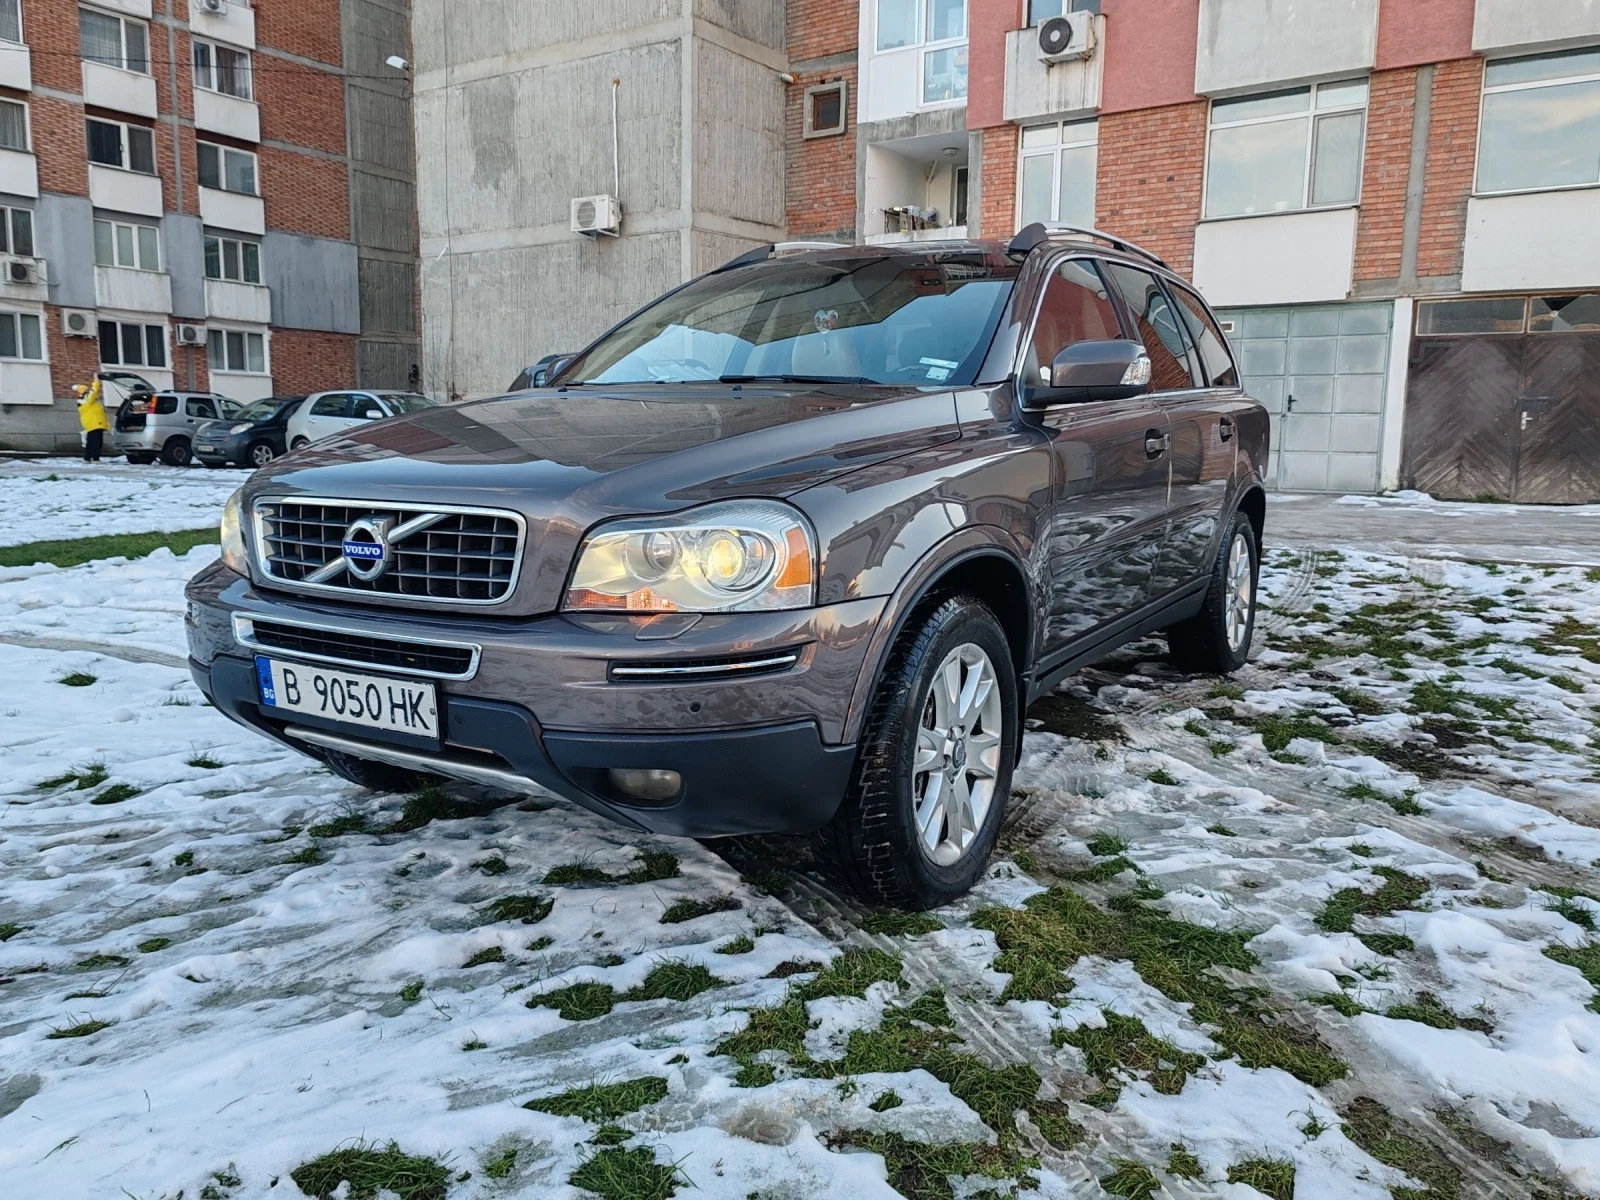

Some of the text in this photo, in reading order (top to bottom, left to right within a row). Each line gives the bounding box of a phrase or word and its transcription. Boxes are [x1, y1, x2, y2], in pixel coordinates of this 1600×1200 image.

[344, 544, 381, 556] VOLVO
[263, 687, 275, 700] BG
[282, 668, 431, 731] B 9050 HK
